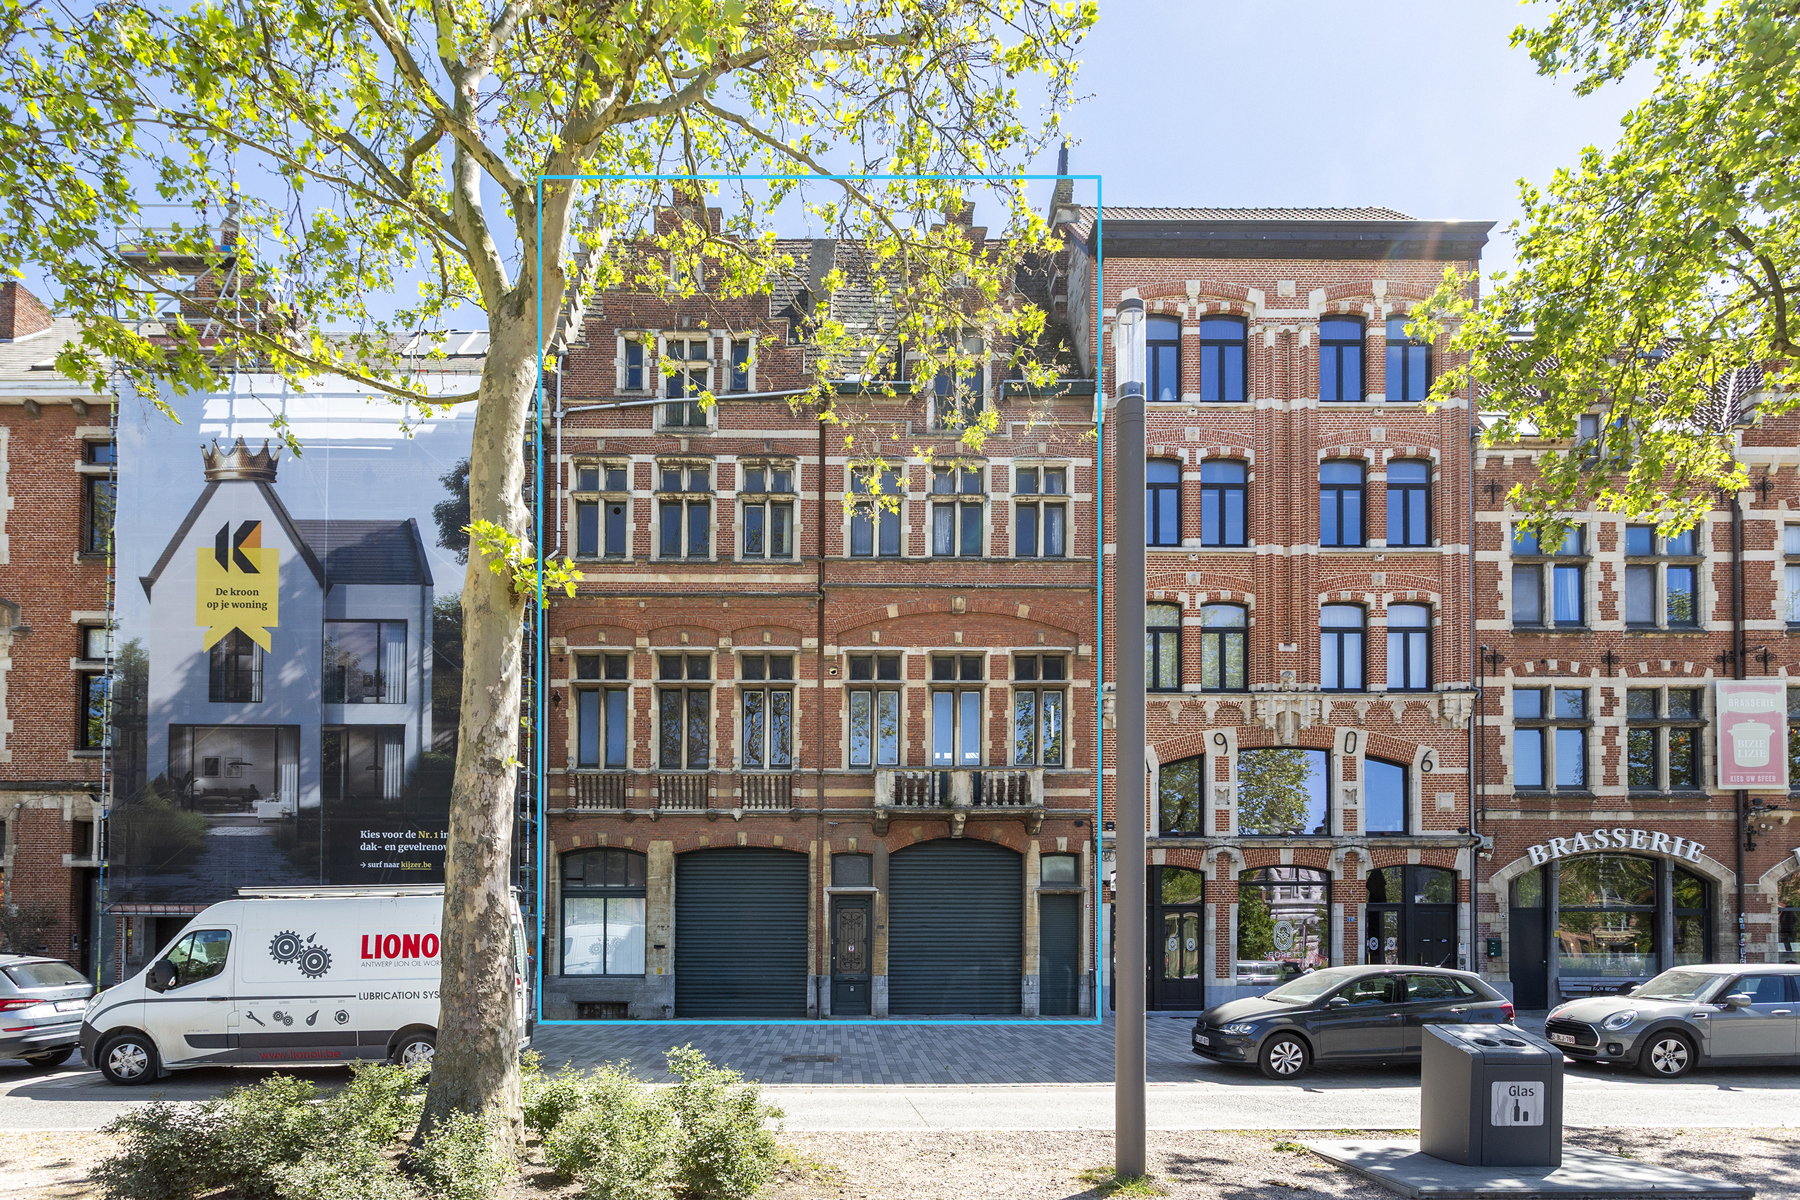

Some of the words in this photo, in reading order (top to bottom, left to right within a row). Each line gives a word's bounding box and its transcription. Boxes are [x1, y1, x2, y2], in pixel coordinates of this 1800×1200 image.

[215, 587, 228, 596] De
[230, 587, 259, 596] kroon
[206, 601, 219, 611] op
[220, 600, 230, 611] je
[231, 600, 268, 611] woning
[1728, 698, 1775, 707] BRASSERIE
[1737, 739, 1766, 748] BIZIE
[1737, 749, 1767, 758] LIZIE
[1730, 775, 1744, 783] KIES
[1746, 775, 1755, 783] UW
[1757, 775, 1777, 783] SFEER
[360, 830, 381, 839] Kies
[405, 830, 416, 839] de
[417, 830, 433, 839] Nr.
[360, 842, 382, 851] dak-
[1527, 828, 1706, 866] BRASSERIE
[367, 860, 383, 868] surf
[400, 860, 432, 870] kijzer.be
[361, 933, 442, 959] LIONO
[358, 991, 420, 1001] LUBRICATION
[259, 1049, 341, 1059] www.lionoil.be
[1508, 1085, 1535, 1097] Glas
